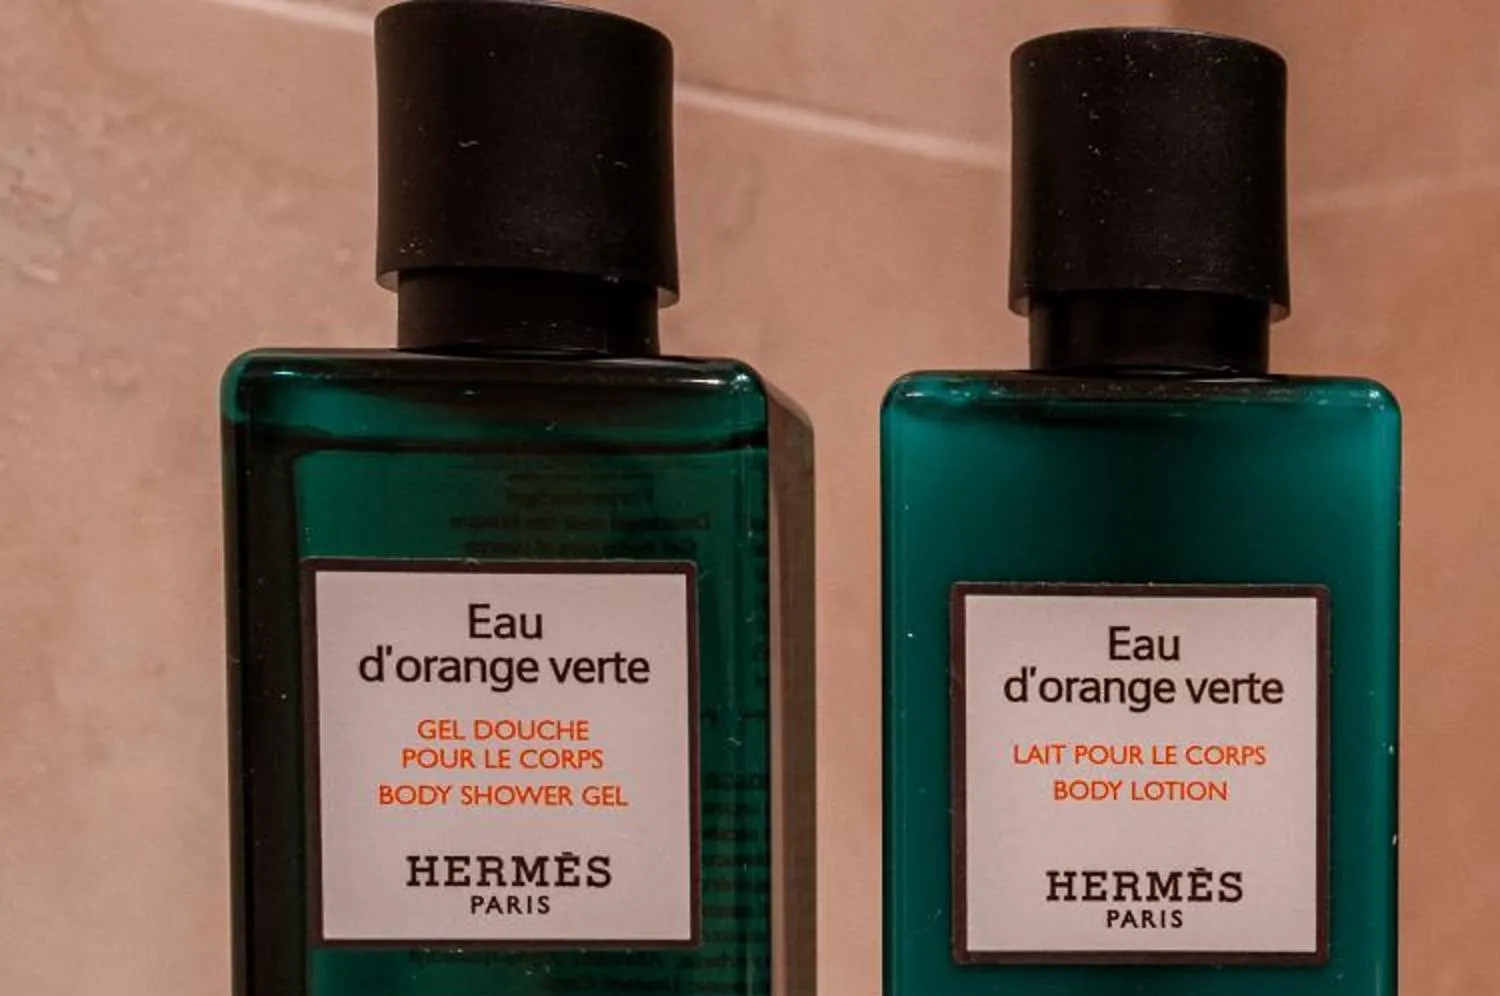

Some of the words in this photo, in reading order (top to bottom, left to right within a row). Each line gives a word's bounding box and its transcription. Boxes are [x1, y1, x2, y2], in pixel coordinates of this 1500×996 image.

[468, 603, 542, 640] Eau
[1109, 626, 1180, 661] Eau
[359, 645, 539, 693] d'orange
[549, 652, 650, 684] verte
[1004, 666, 1176, 713] d'orange
[1185, 673, 1284, 704] verte
[418, 720, 464, 740] GEL
[474, 720, 588, 740] DOUCHE
[402, 749, 475, 768] POUR
[485, 749, 510, 769] LE
[520, 749, 603, 769] CORPS
[1014, 744, 1066, 764] LAIT
[1075, 745, 1143, 764] POUR
[1152, 745, 1177, 765] LE
[1186, 746, 1266, 765] CORPS
[379, 785, 451, 805] BODY
[461, 786, 572, 805] SHOWER
[582, 786, 627, 806] GEL
[1054, 780, 1122, 800] BODY
[1131, 781, 1227, 800] LOTION
[406, 852, 611, 888] HERMÈS
[1046, 867, 1243, 903] HERMÈS
[471, 895, 550, 914] PARIS
[1107, 909, 1183, 928] PARIS
